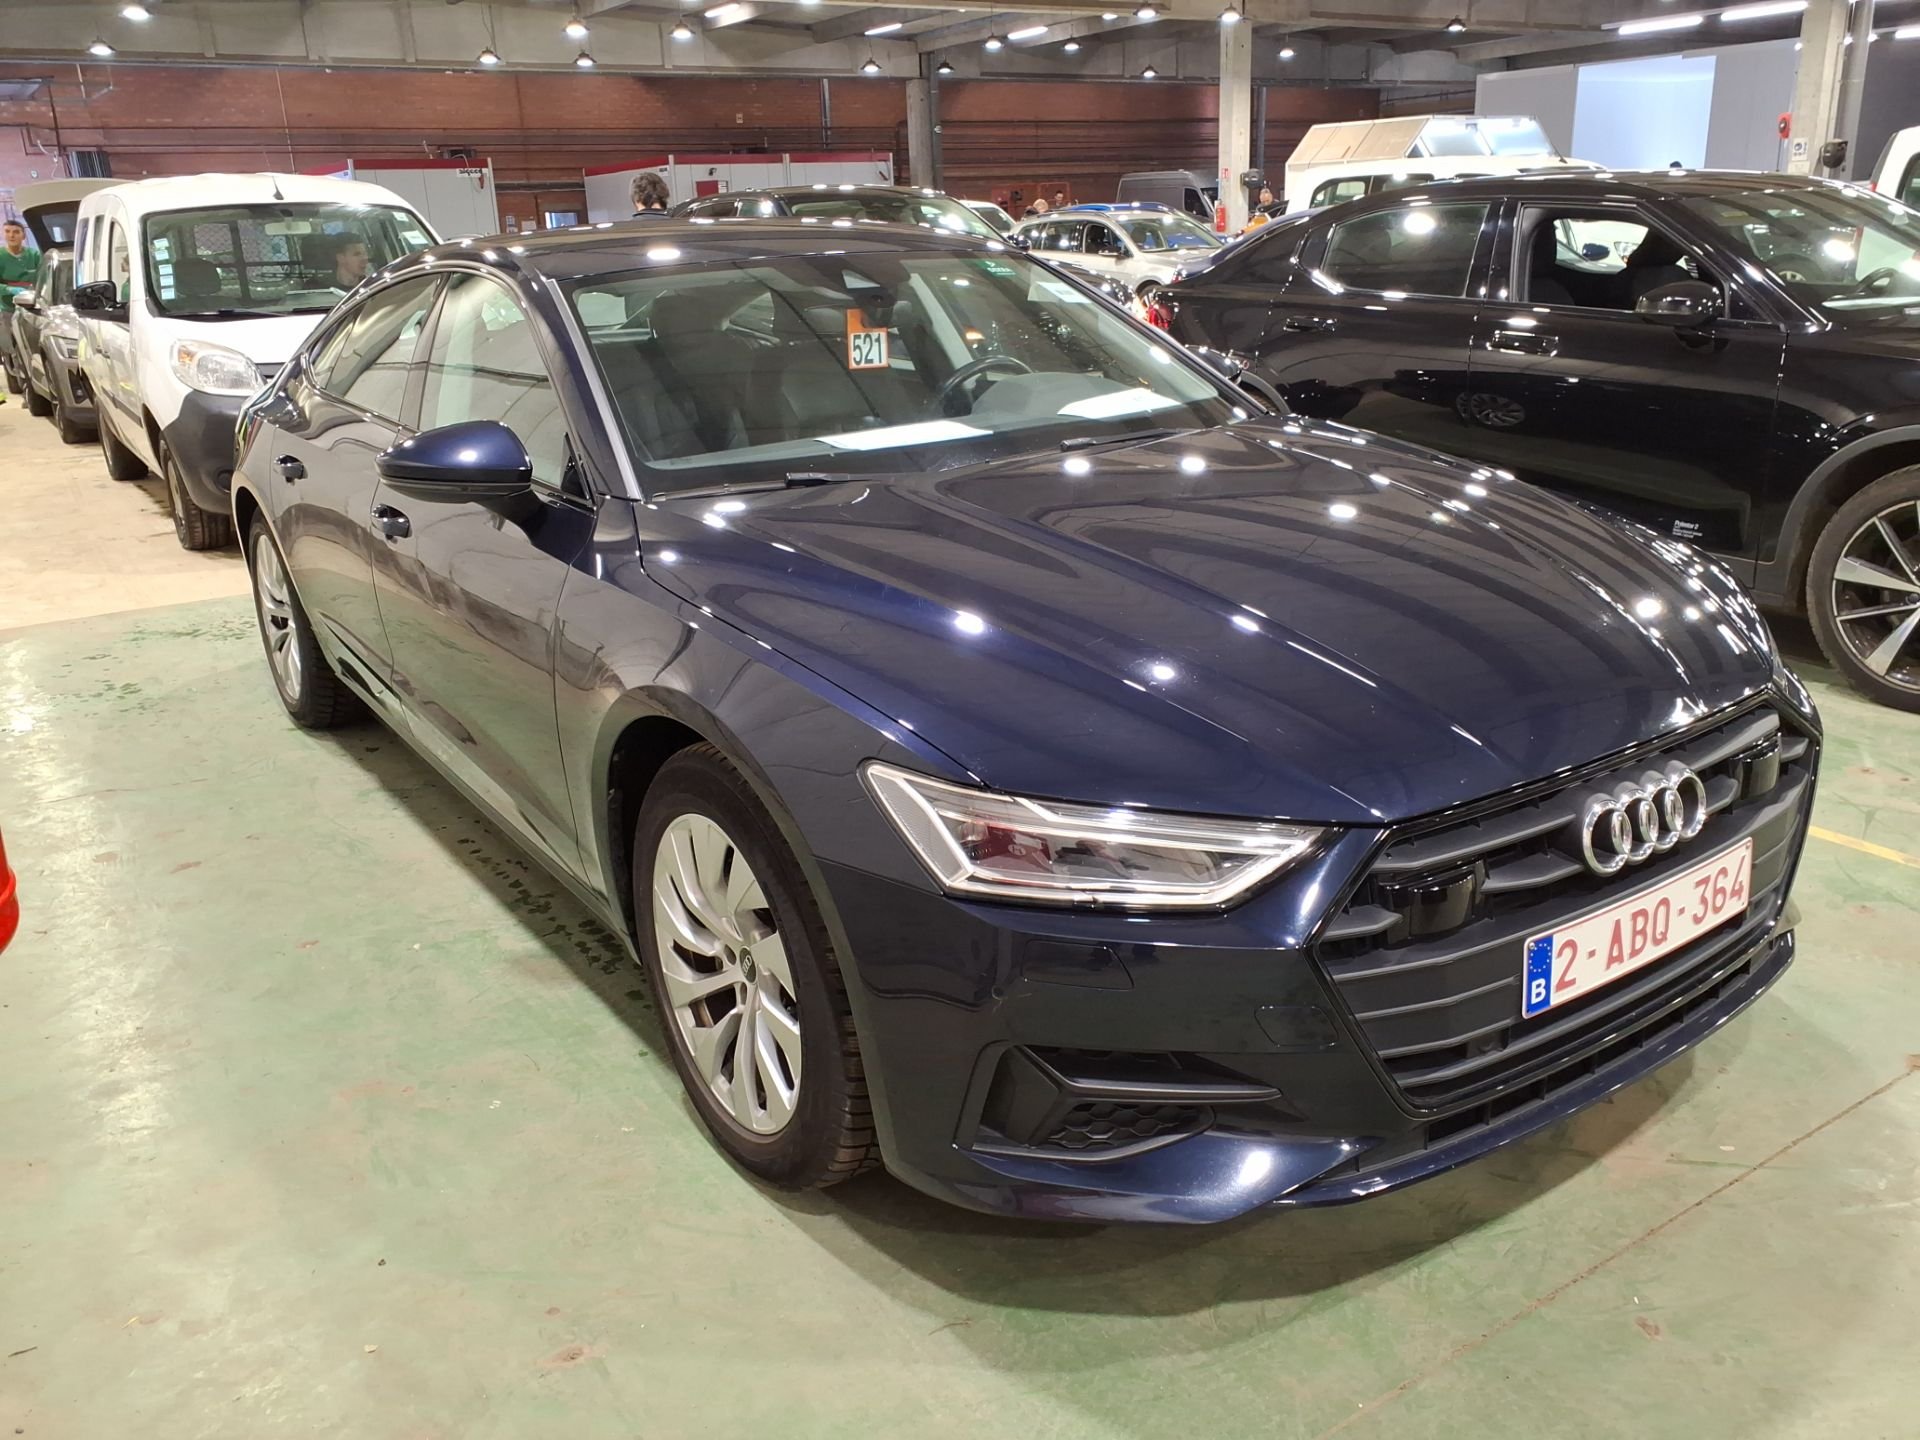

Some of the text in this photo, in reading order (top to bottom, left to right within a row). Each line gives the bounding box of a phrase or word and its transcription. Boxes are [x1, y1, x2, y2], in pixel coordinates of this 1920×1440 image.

[853, 333, 882, 366] 521
[1554, 854, 1747, 993] 2-ABQ-364
[1530, 978, 1546, 1004] B
